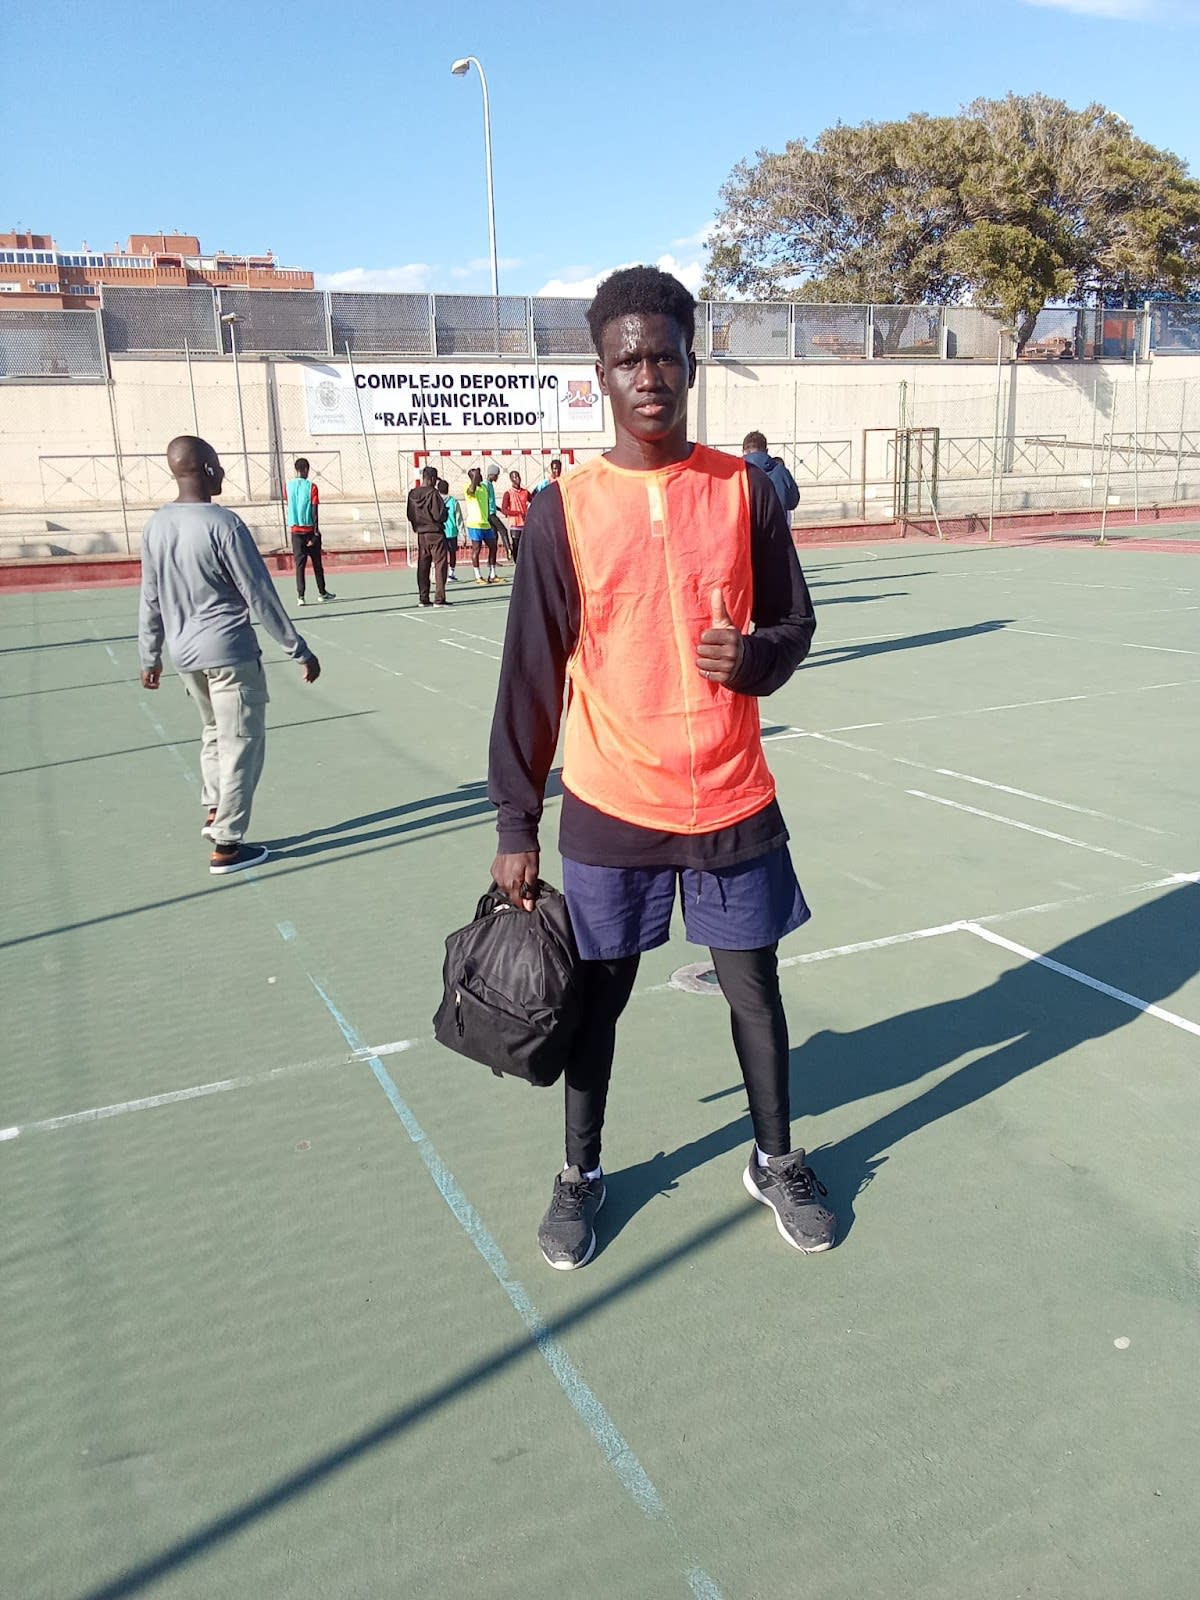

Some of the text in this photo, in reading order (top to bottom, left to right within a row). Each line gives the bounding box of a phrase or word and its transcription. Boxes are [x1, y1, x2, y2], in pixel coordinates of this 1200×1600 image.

[355, 374, 558, 389] COMPLEJO DEPORTIVO
[411, 393, 509, 408] MUNICIPAL
[374, 412, 452, 427] “RAFAEL
